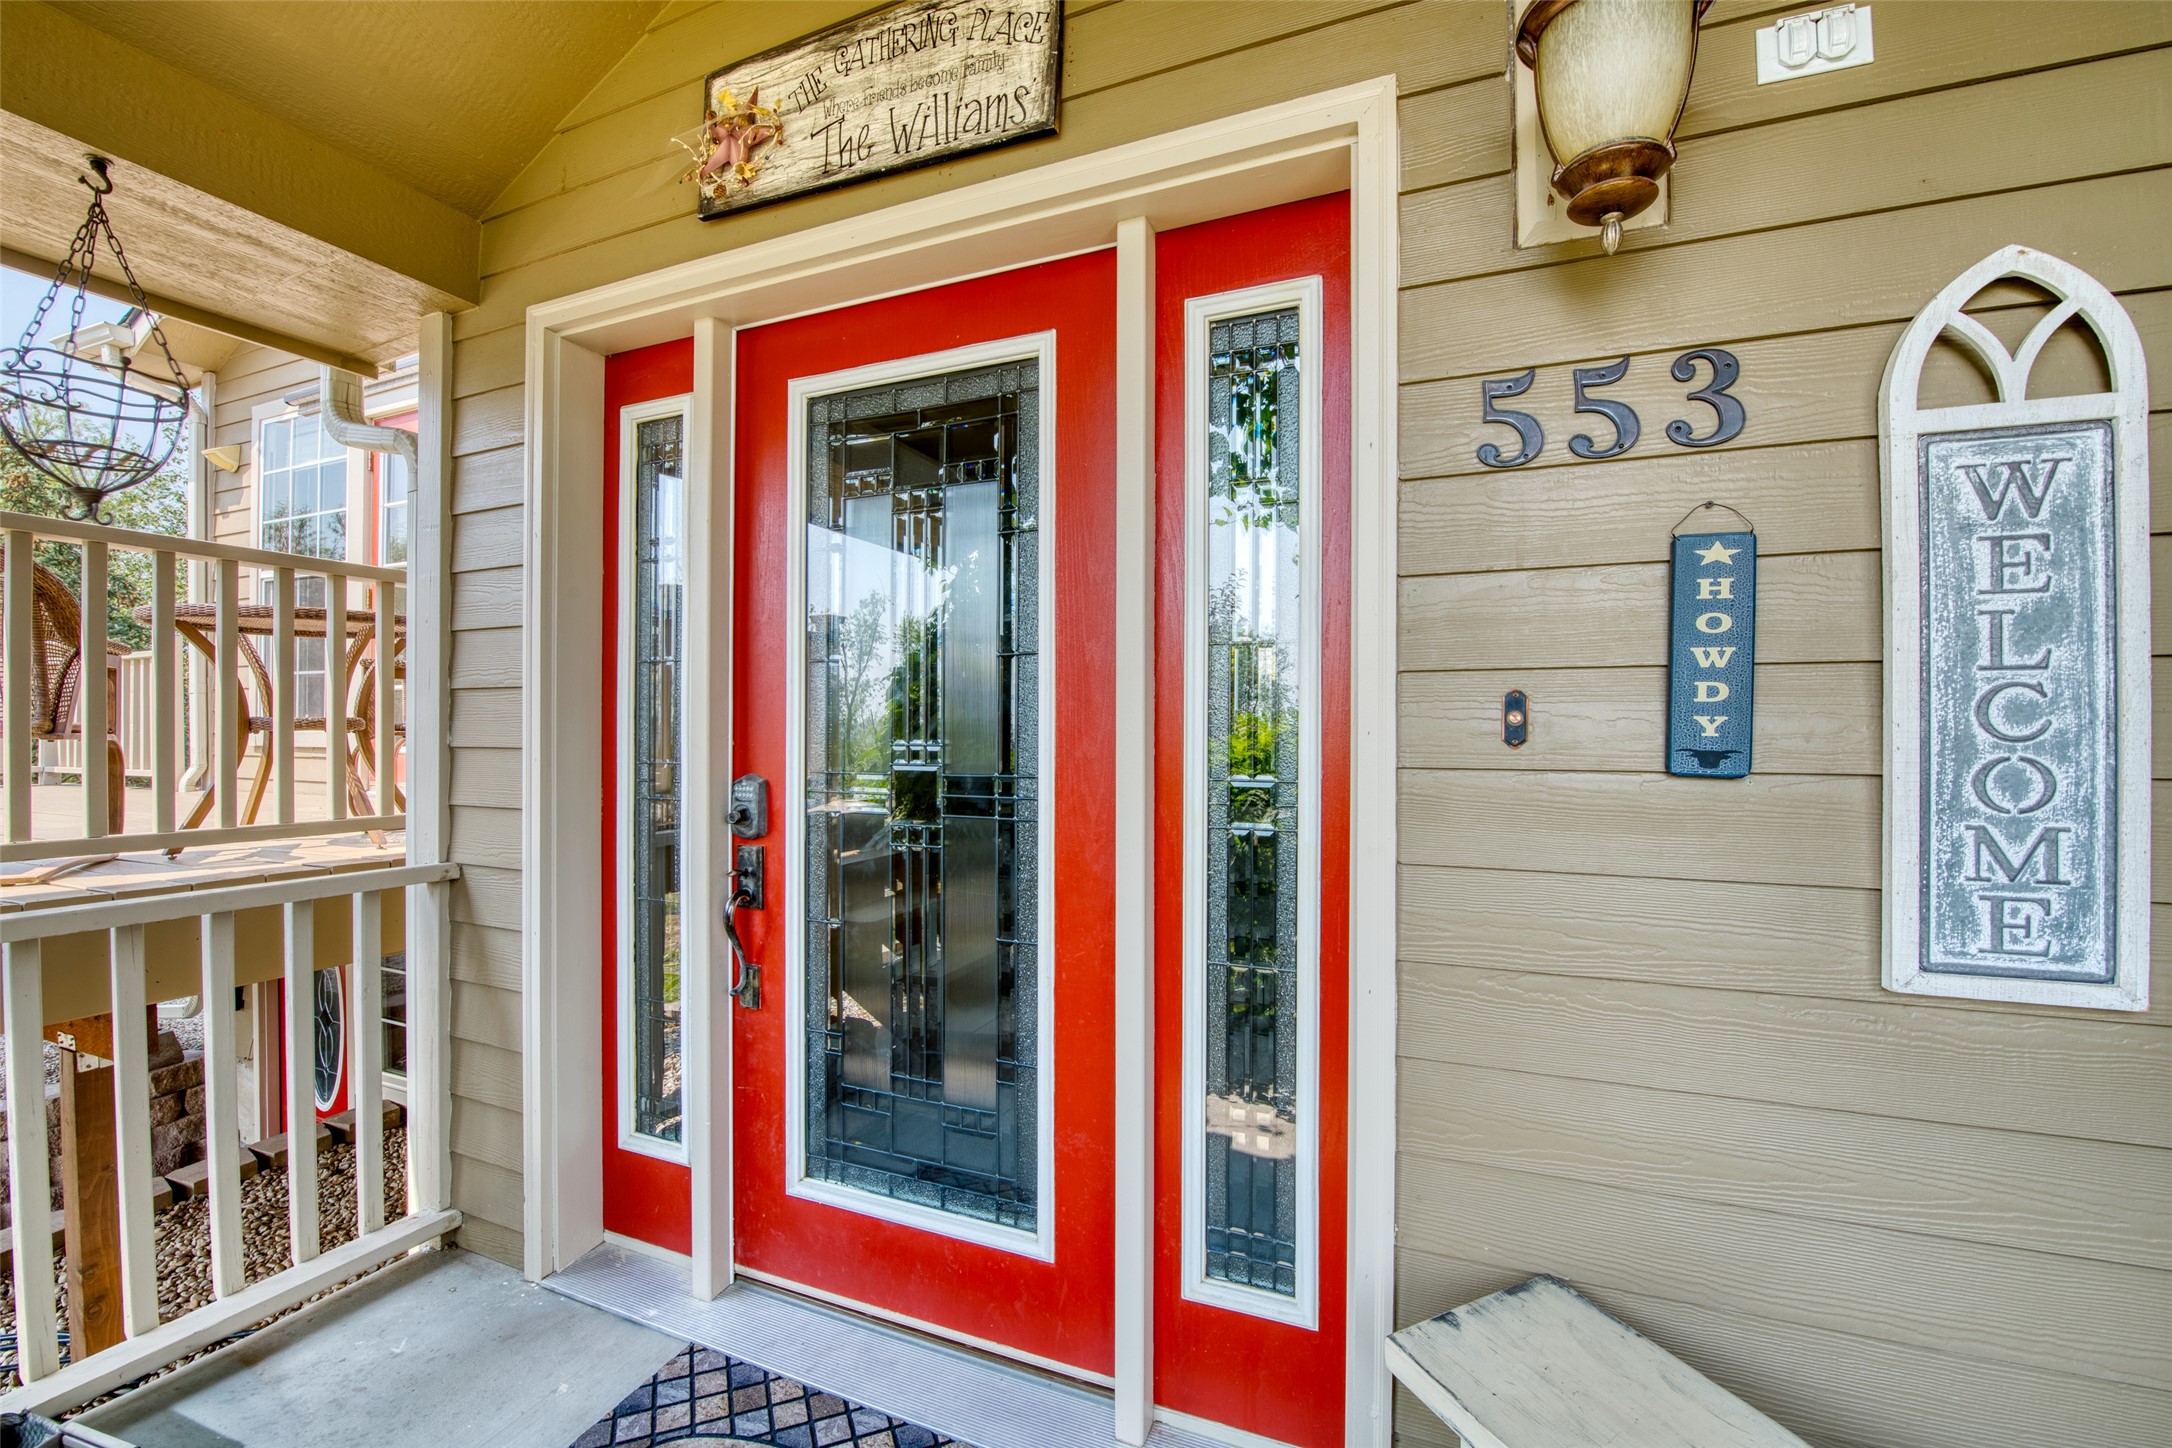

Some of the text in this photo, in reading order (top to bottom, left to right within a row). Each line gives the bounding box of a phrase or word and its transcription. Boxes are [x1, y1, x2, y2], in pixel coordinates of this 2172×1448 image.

[788, 8, 1051, 115] THE GATHERING PLACE
[822, 49, 1006, 120] Where Friends become Family
[811, 114, 875, 174] The
[1477, 348, 1747, 468] 553
[1690, 577, 1737, 737] HOWDY
[1955, 457, 2073, 958] WELCOME
